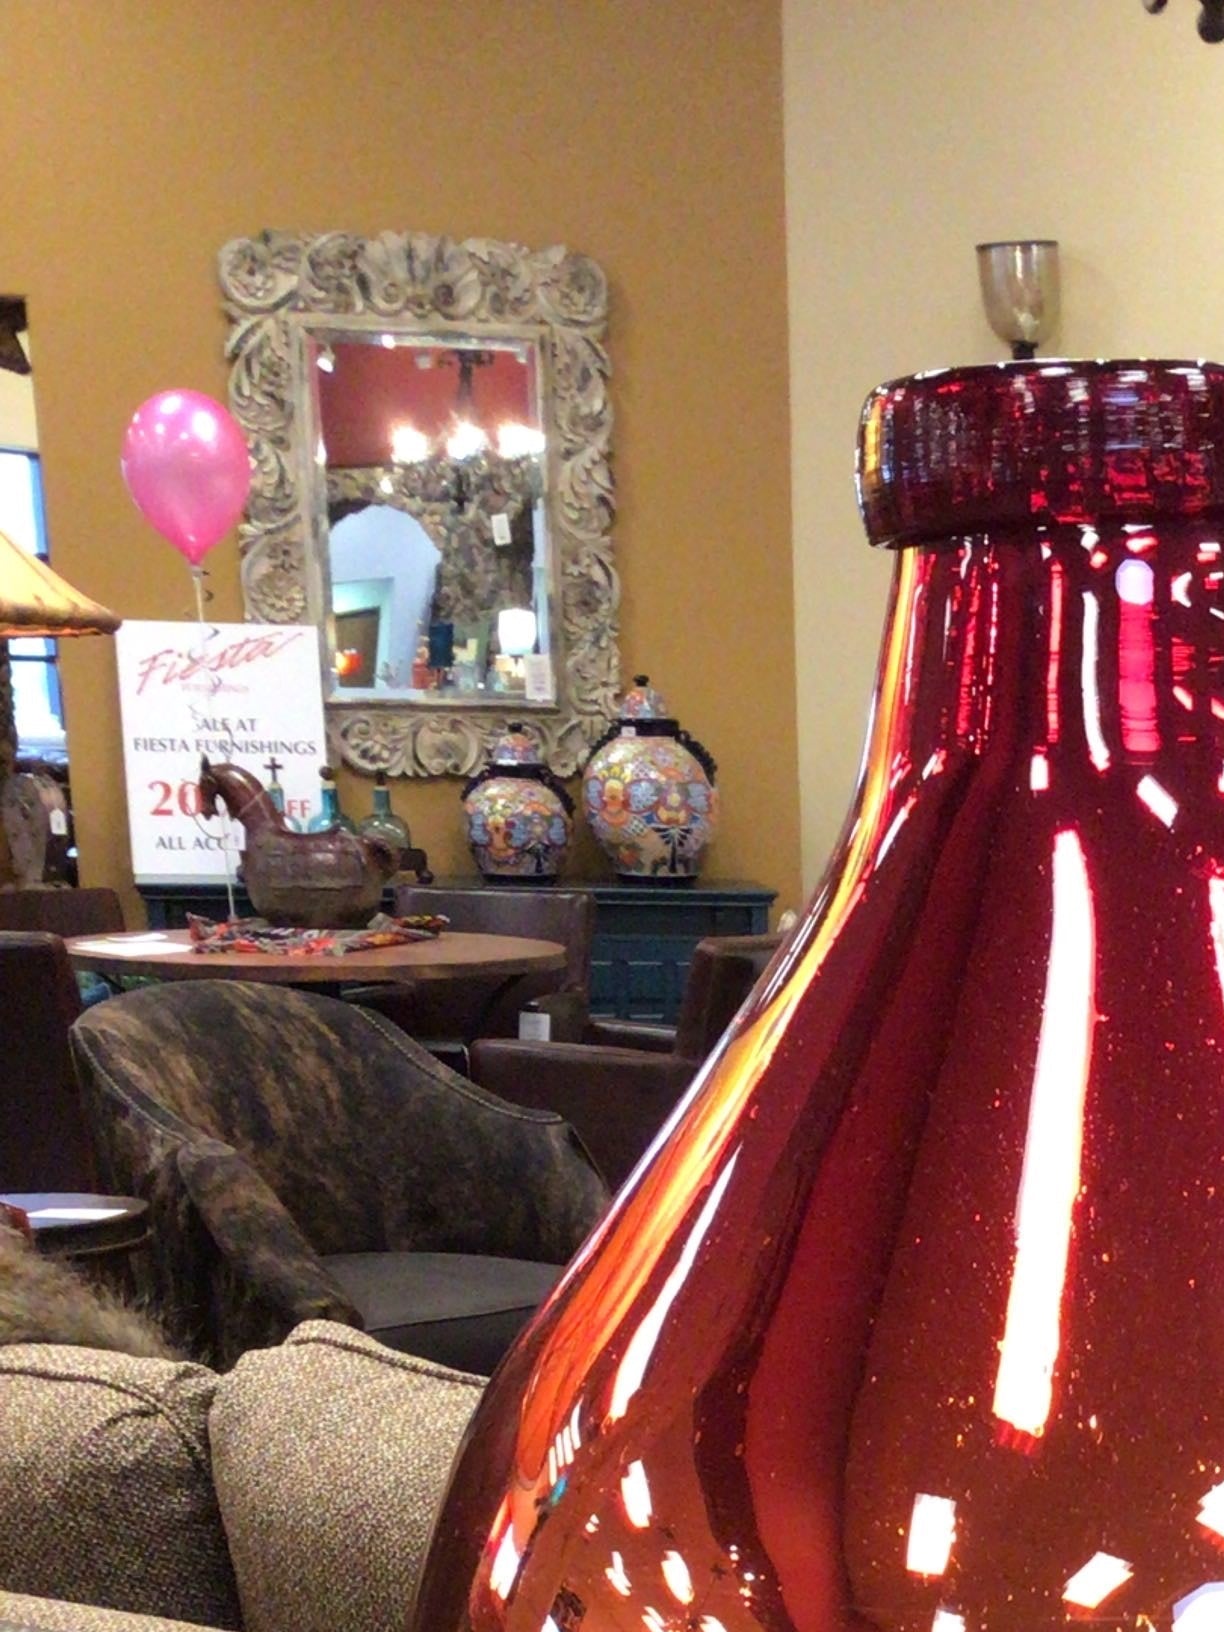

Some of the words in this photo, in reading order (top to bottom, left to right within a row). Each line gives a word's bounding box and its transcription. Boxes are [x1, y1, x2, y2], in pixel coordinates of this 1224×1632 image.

[136, 631, 303, 695] Fiesta
[195, 717, 232, 732] SALE
[237, 717, 257, 732] AT
[133, 737, 190, 753] FIESTA
[196, 738, 317, 756] FURNISHINGS
[287, 799, 311, 817] FF
[155, 836, 186, 850] ALL
